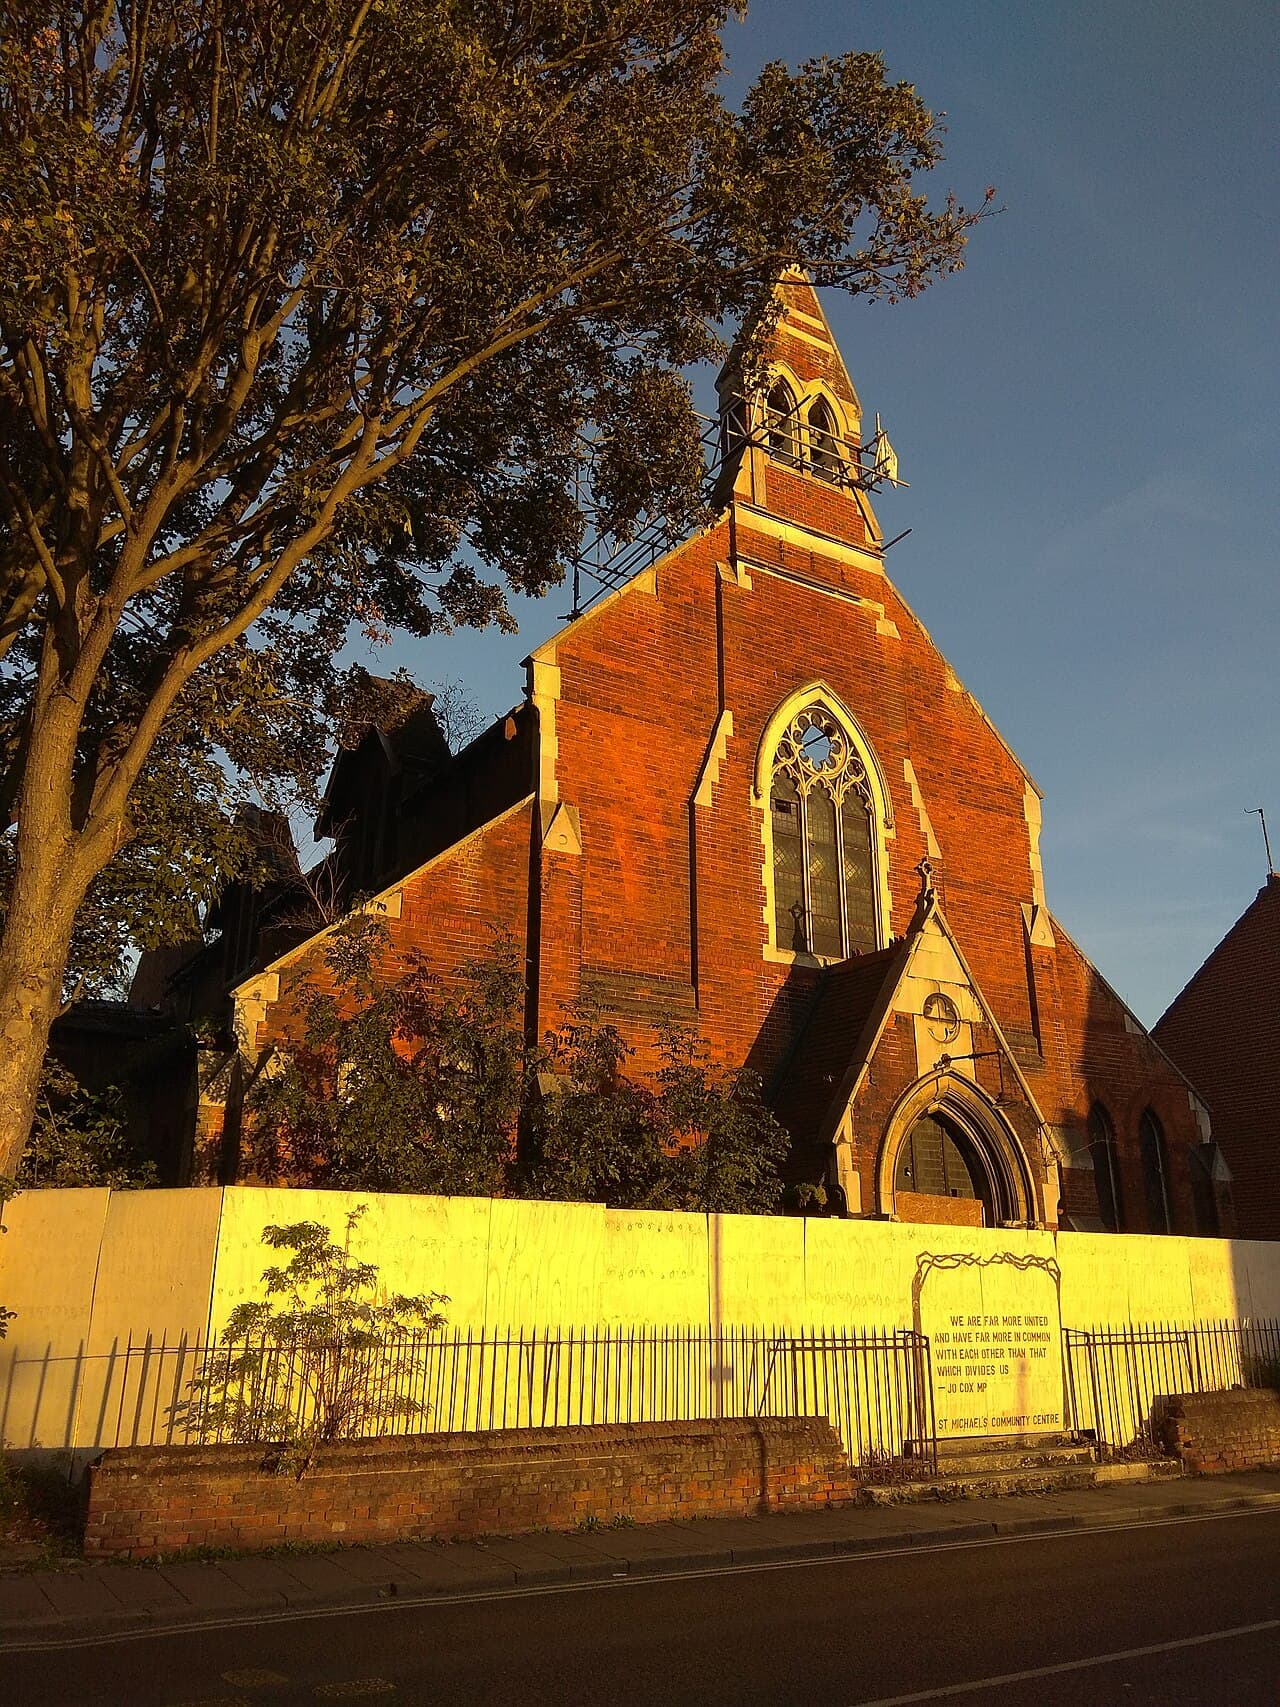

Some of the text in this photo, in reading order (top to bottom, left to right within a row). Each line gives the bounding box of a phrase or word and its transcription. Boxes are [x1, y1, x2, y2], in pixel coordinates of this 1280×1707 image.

[950, 1315, 1048, 1326] WE ARE FAR MORE UNITED
[934, 1332, 1051, 1343] AND HAVE FAR MORE IN COMMON
[935, 1347, 1047, 1360] WITH EACH OTHER THAN THAT
[936, 1364, 1009, 1376] WHICH DIVIDES US
[947, 1383, 957, 1393] JO
[959, 1382, 974, 1392] COX
[977, 1382, 987, 1392] MP
[938, 1414, 1059, 1430] ST MICHAEL'S COMMUNITY CENTRE
